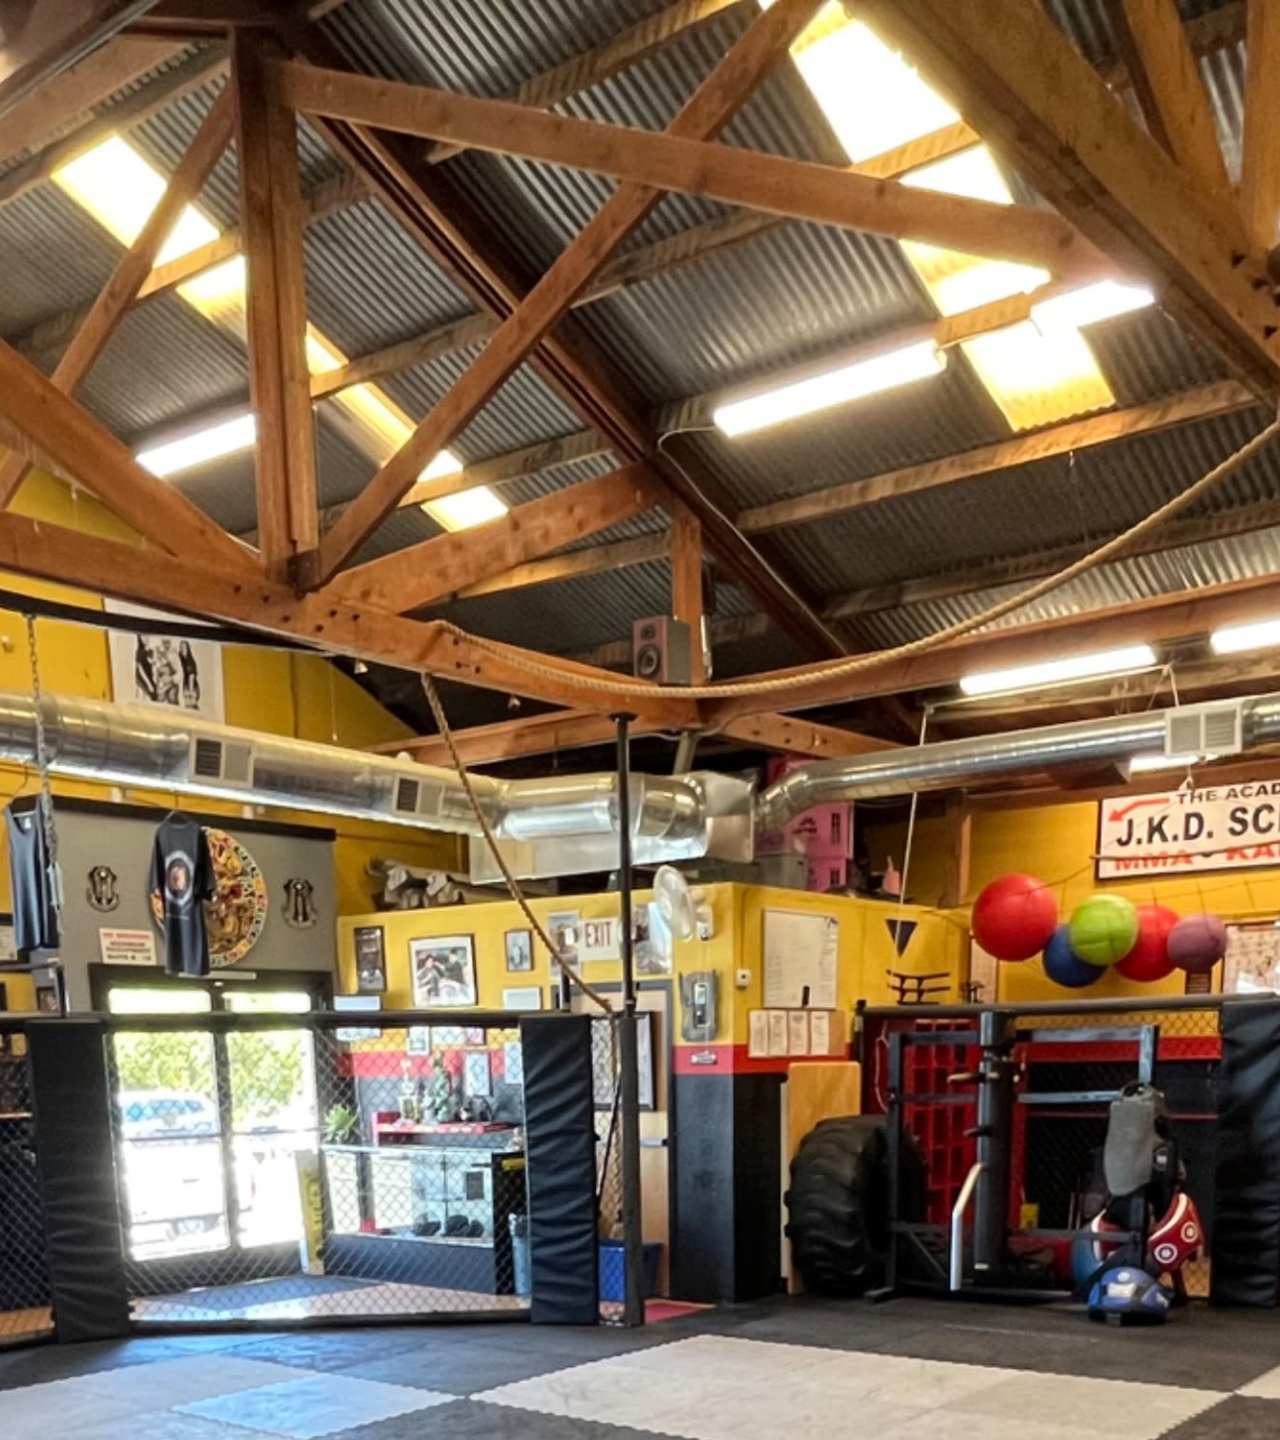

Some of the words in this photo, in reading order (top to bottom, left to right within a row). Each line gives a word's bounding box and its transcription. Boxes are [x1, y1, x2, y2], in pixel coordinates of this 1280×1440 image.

[1177, 790, 1218, 805] THE
[1116, 812, 1214, 847] J.K.D.
[1114, 852, 1194, 872] MMA
[585, 921, 611, 948] EXIT
